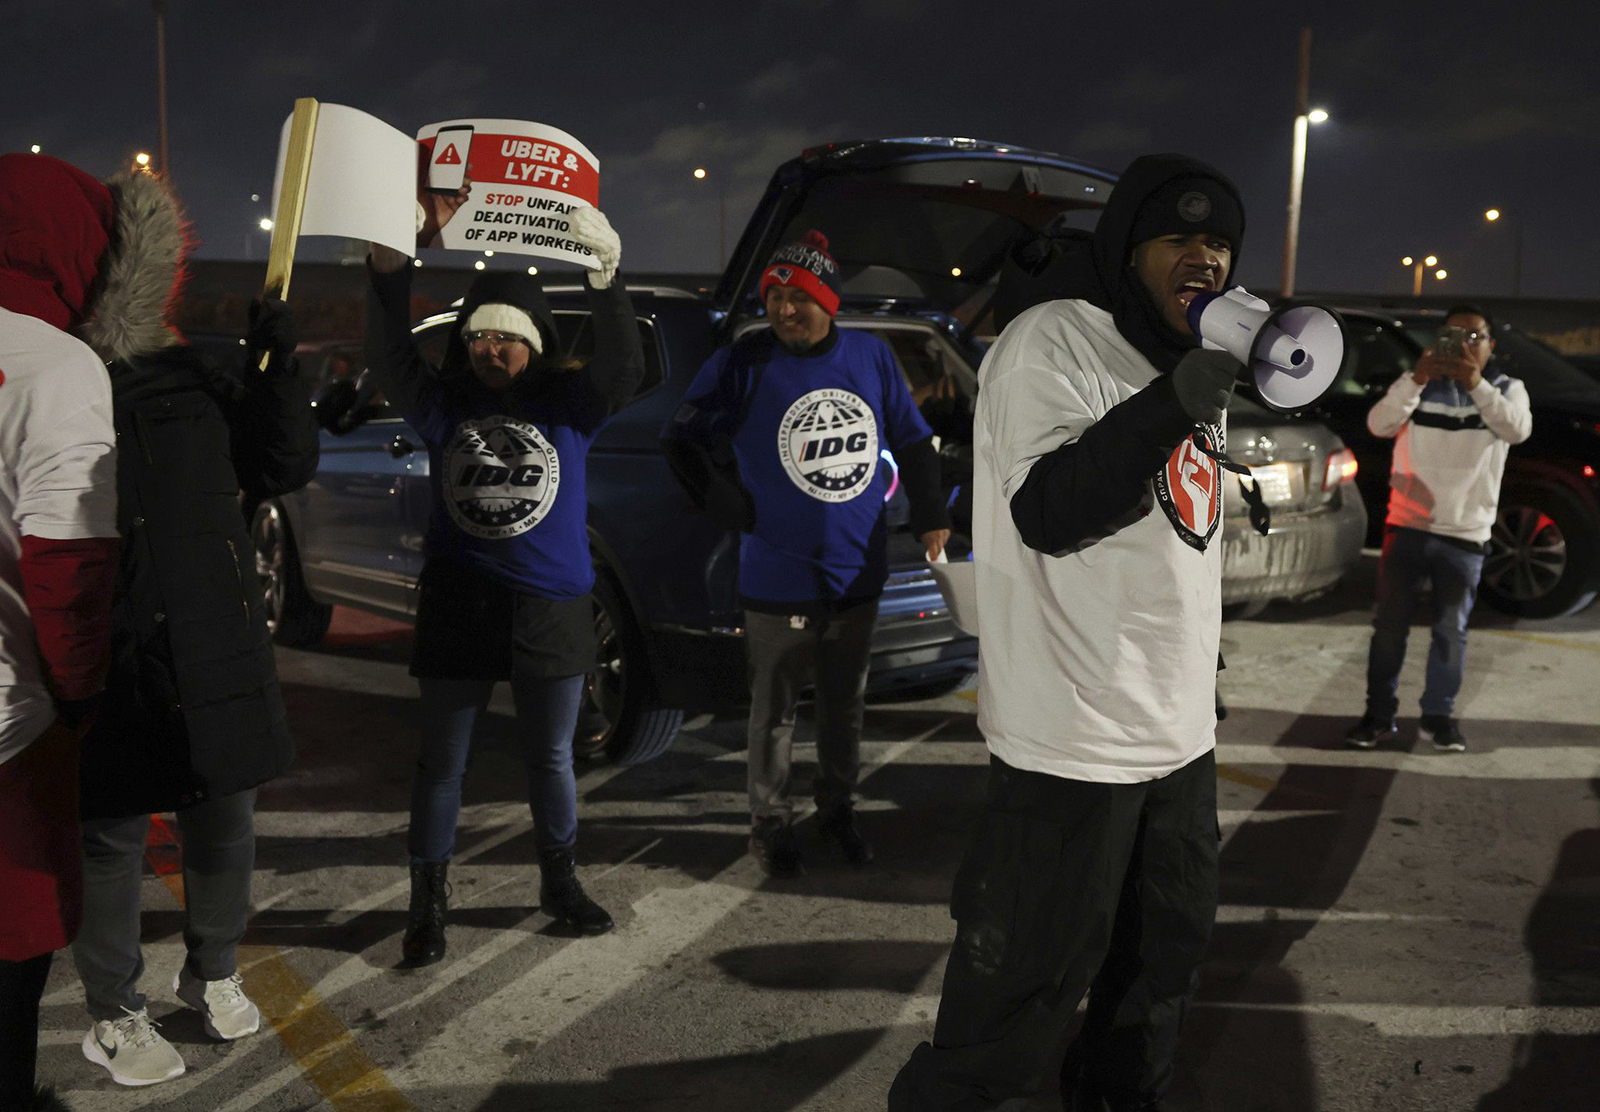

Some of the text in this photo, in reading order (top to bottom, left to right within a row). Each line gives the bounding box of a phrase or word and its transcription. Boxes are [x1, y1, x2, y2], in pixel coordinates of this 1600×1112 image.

[501, 139, 578, 172] UBER &
[504, 161, 570, 188] LYFT:
[485, 193, 524, 207] STOP
[473, 210, 571, 232] DEACTIVATIO
[465, 228, 593, 257] OF APP WORKERS
[780, 396, 812, 462] INDEPENDENT
[822, 391, 861, 407] DRIVERS
[799, 432, 868, 463] IDG
[457, 464, 544, 487] IDG
[546, 447, 558, 484] GUILD
[523, 515, 538, 527] MA
